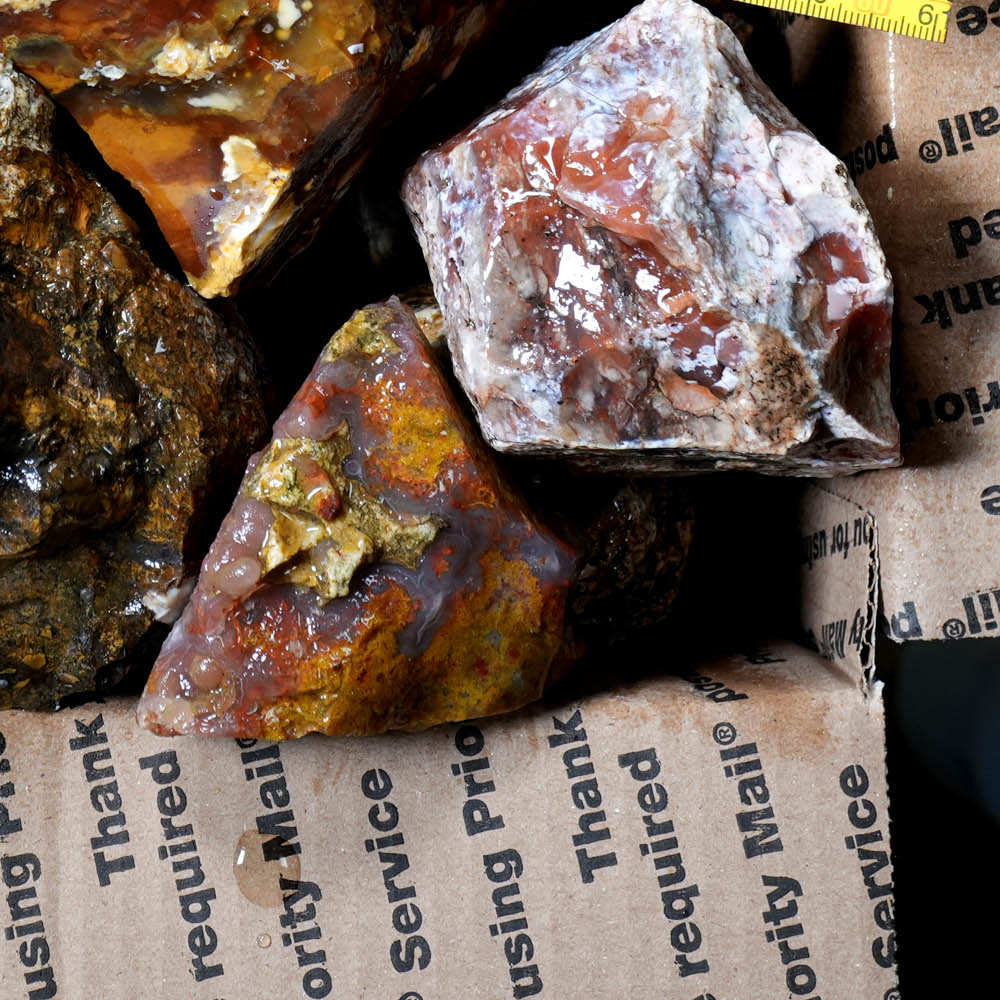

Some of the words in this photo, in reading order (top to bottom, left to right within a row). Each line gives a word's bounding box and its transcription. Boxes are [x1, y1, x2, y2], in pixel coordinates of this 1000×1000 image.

[70, 713, 136, 887] Thank
[138, 749, 225, 982] required
[361, 768, 431, 973] Service
[548, 708, 618, 884] Thank
[617, 747, 709, 978] required
[712, 721, 783, 859] Mail®
[839, 764, 899, 969] Service
[0, 851, 58, 1000] using
[483, 848, 544, 999] using
[762, 875, 821, 1000] ority
